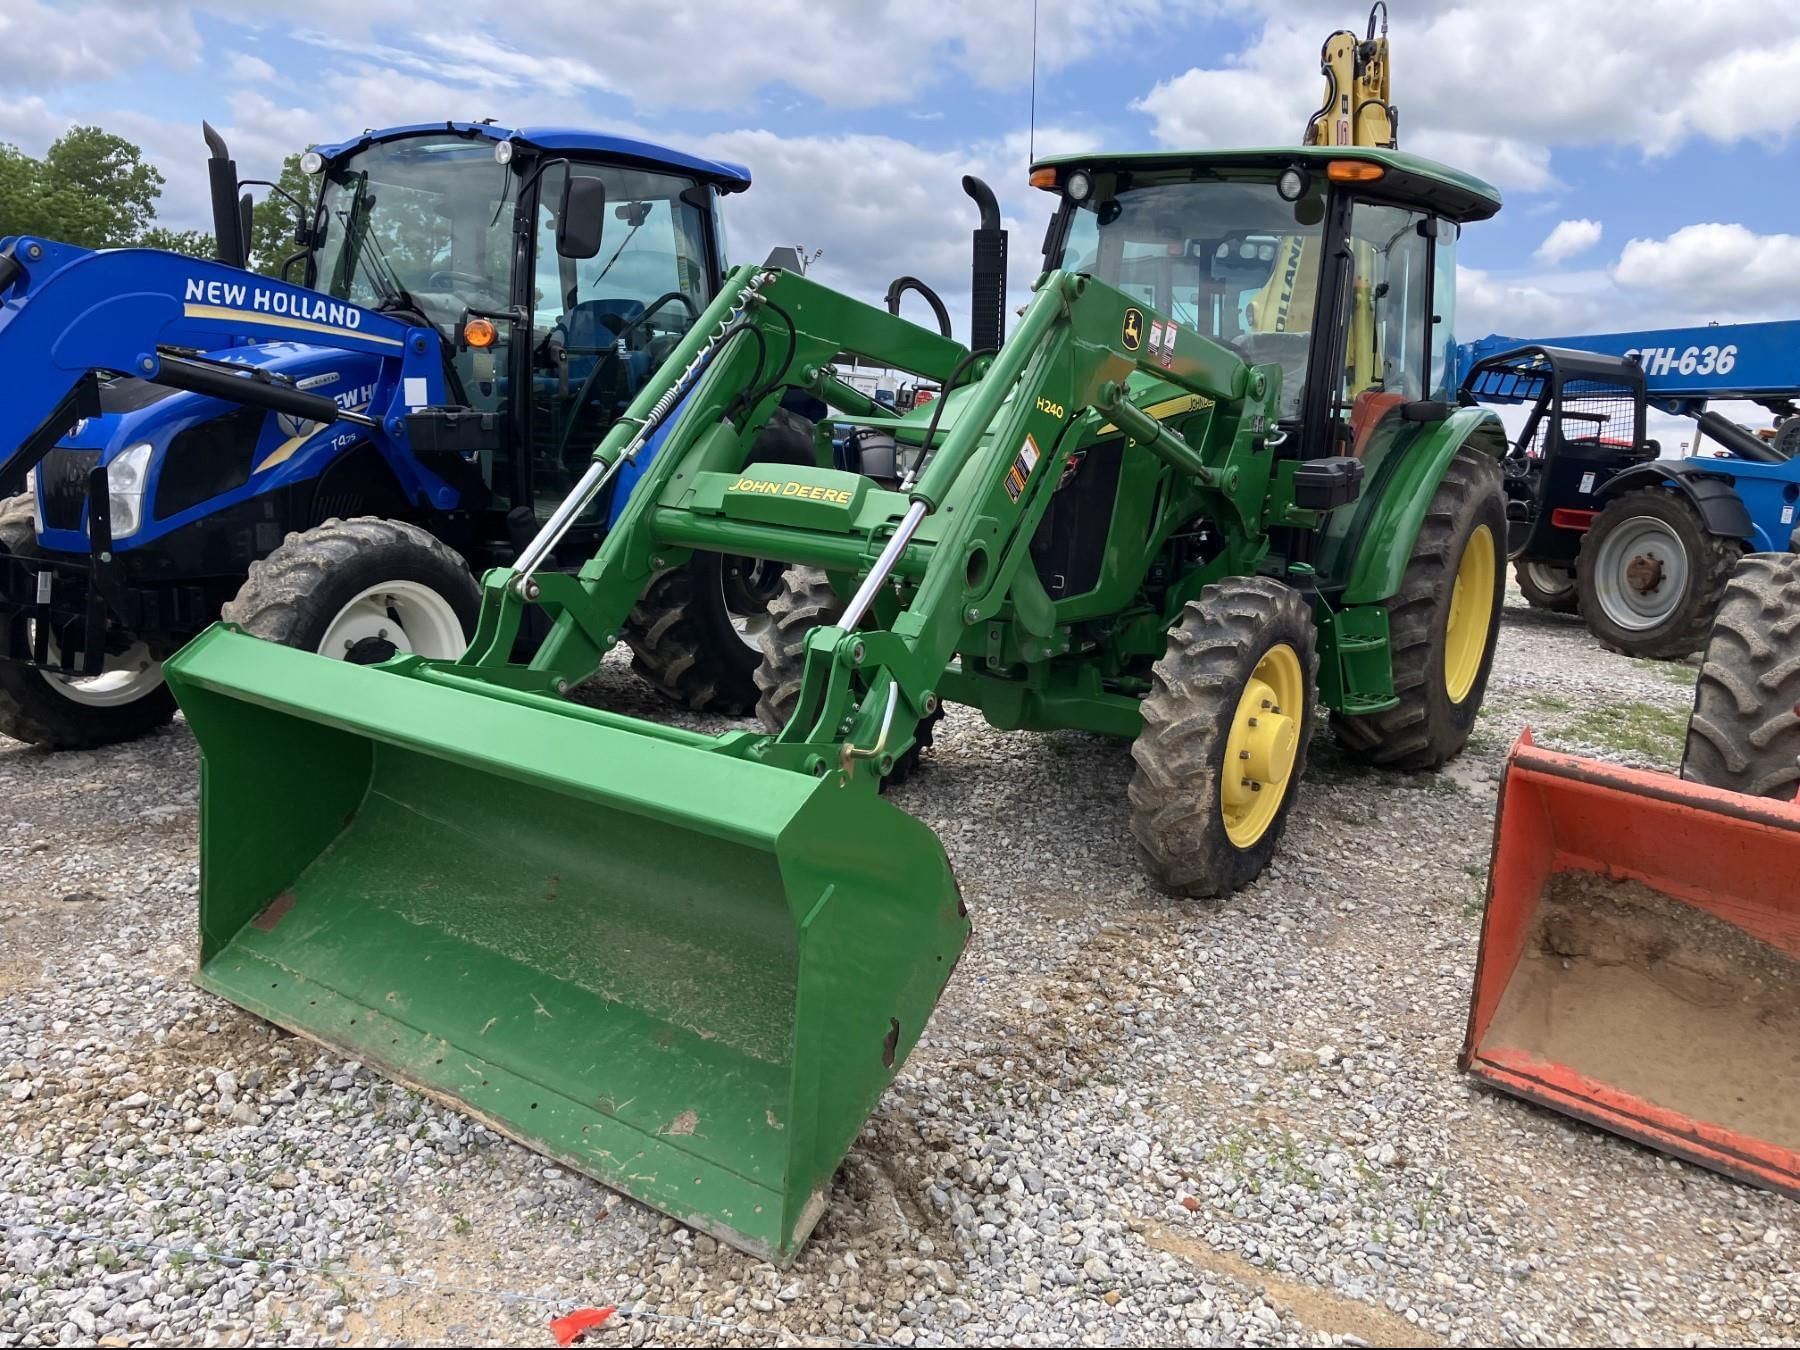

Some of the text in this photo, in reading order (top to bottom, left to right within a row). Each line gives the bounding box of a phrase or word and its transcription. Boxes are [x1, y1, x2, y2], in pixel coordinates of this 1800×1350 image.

[185, 278, 361, 329] NEW HOLLAND
[334, 388, 358, 409] EW
[1036, 396, 1064, 419] H240
[728, 478, 852, 504] JOHN DEERE
